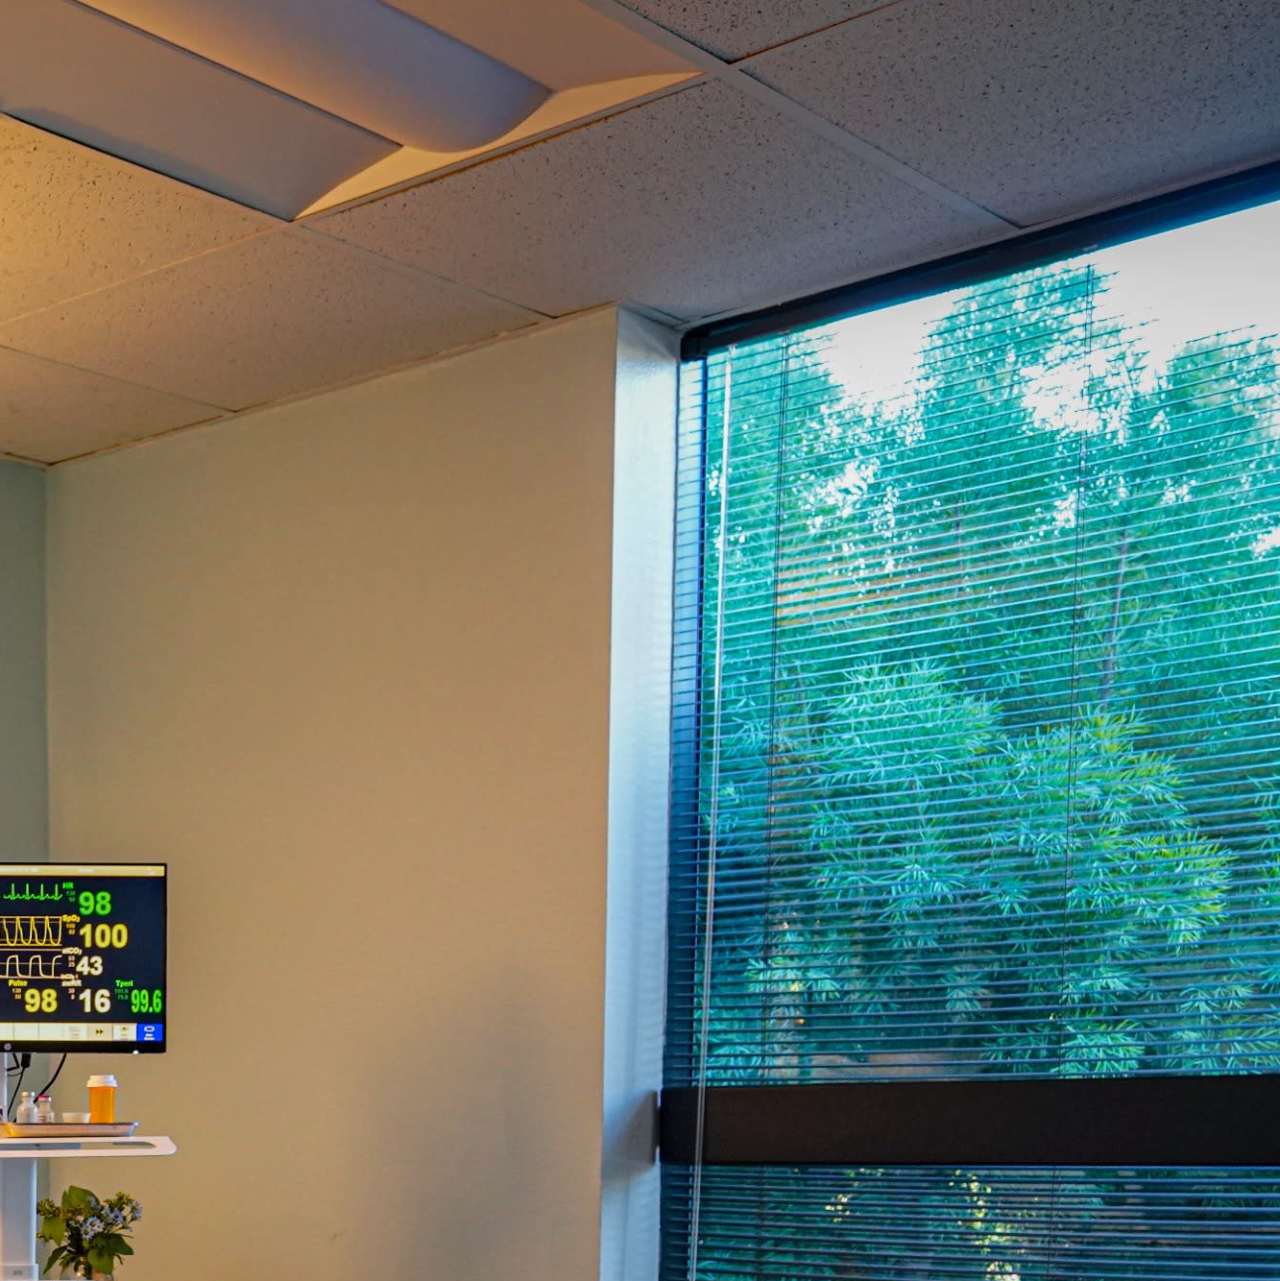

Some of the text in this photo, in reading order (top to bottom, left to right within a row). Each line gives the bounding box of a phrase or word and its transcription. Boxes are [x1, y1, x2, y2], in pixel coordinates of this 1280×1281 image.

[79, 891, 112, 916] 98
[79, 923, 128, 949] 100
[76, 956, 103, 976] 43
[24, 988, 58, 1013] 98
[79, 988, 111, 1013] 16
[131, 989, 162, 1013] 99.6
